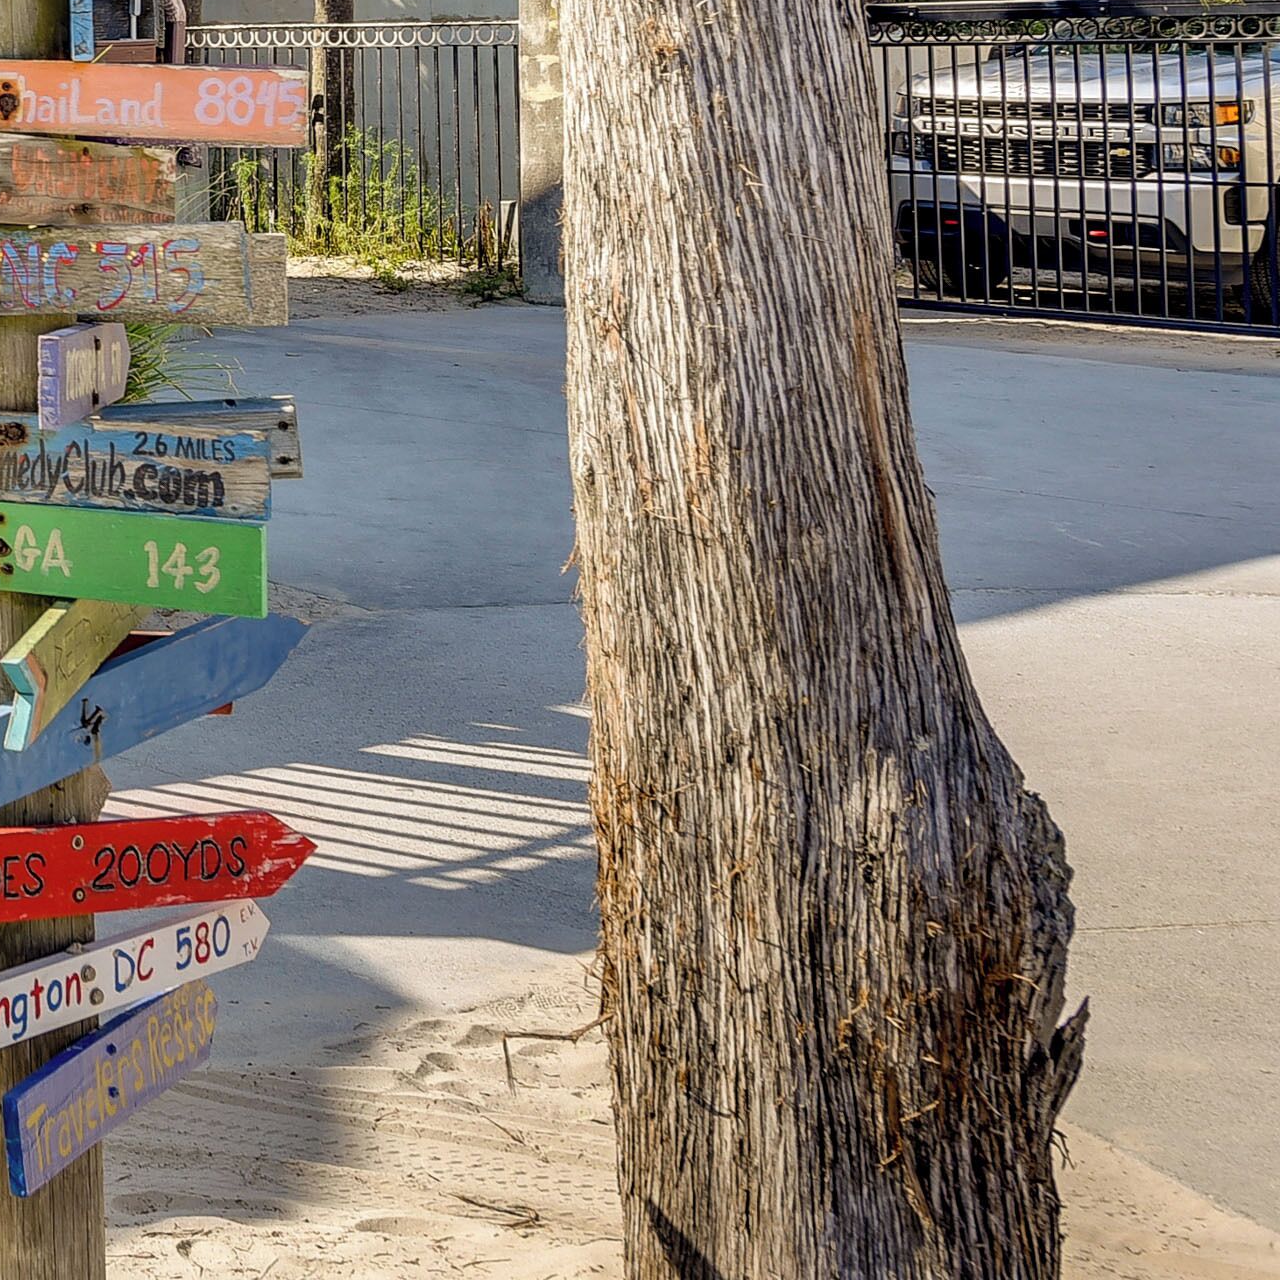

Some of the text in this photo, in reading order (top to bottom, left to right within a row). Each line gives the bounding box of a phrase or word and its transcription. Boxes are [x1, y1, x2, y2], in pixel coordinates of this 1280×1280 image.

[194, 76, 303, 127] 8845
[0, 238, 80, 309] NC
[175, 436, 235, 462] MILES
[13, 526, 73, 577] GA
[144, 540, 222, 594] 143
[114, 939, 154, 993] DC
[176, 915, 231, 970] 580
